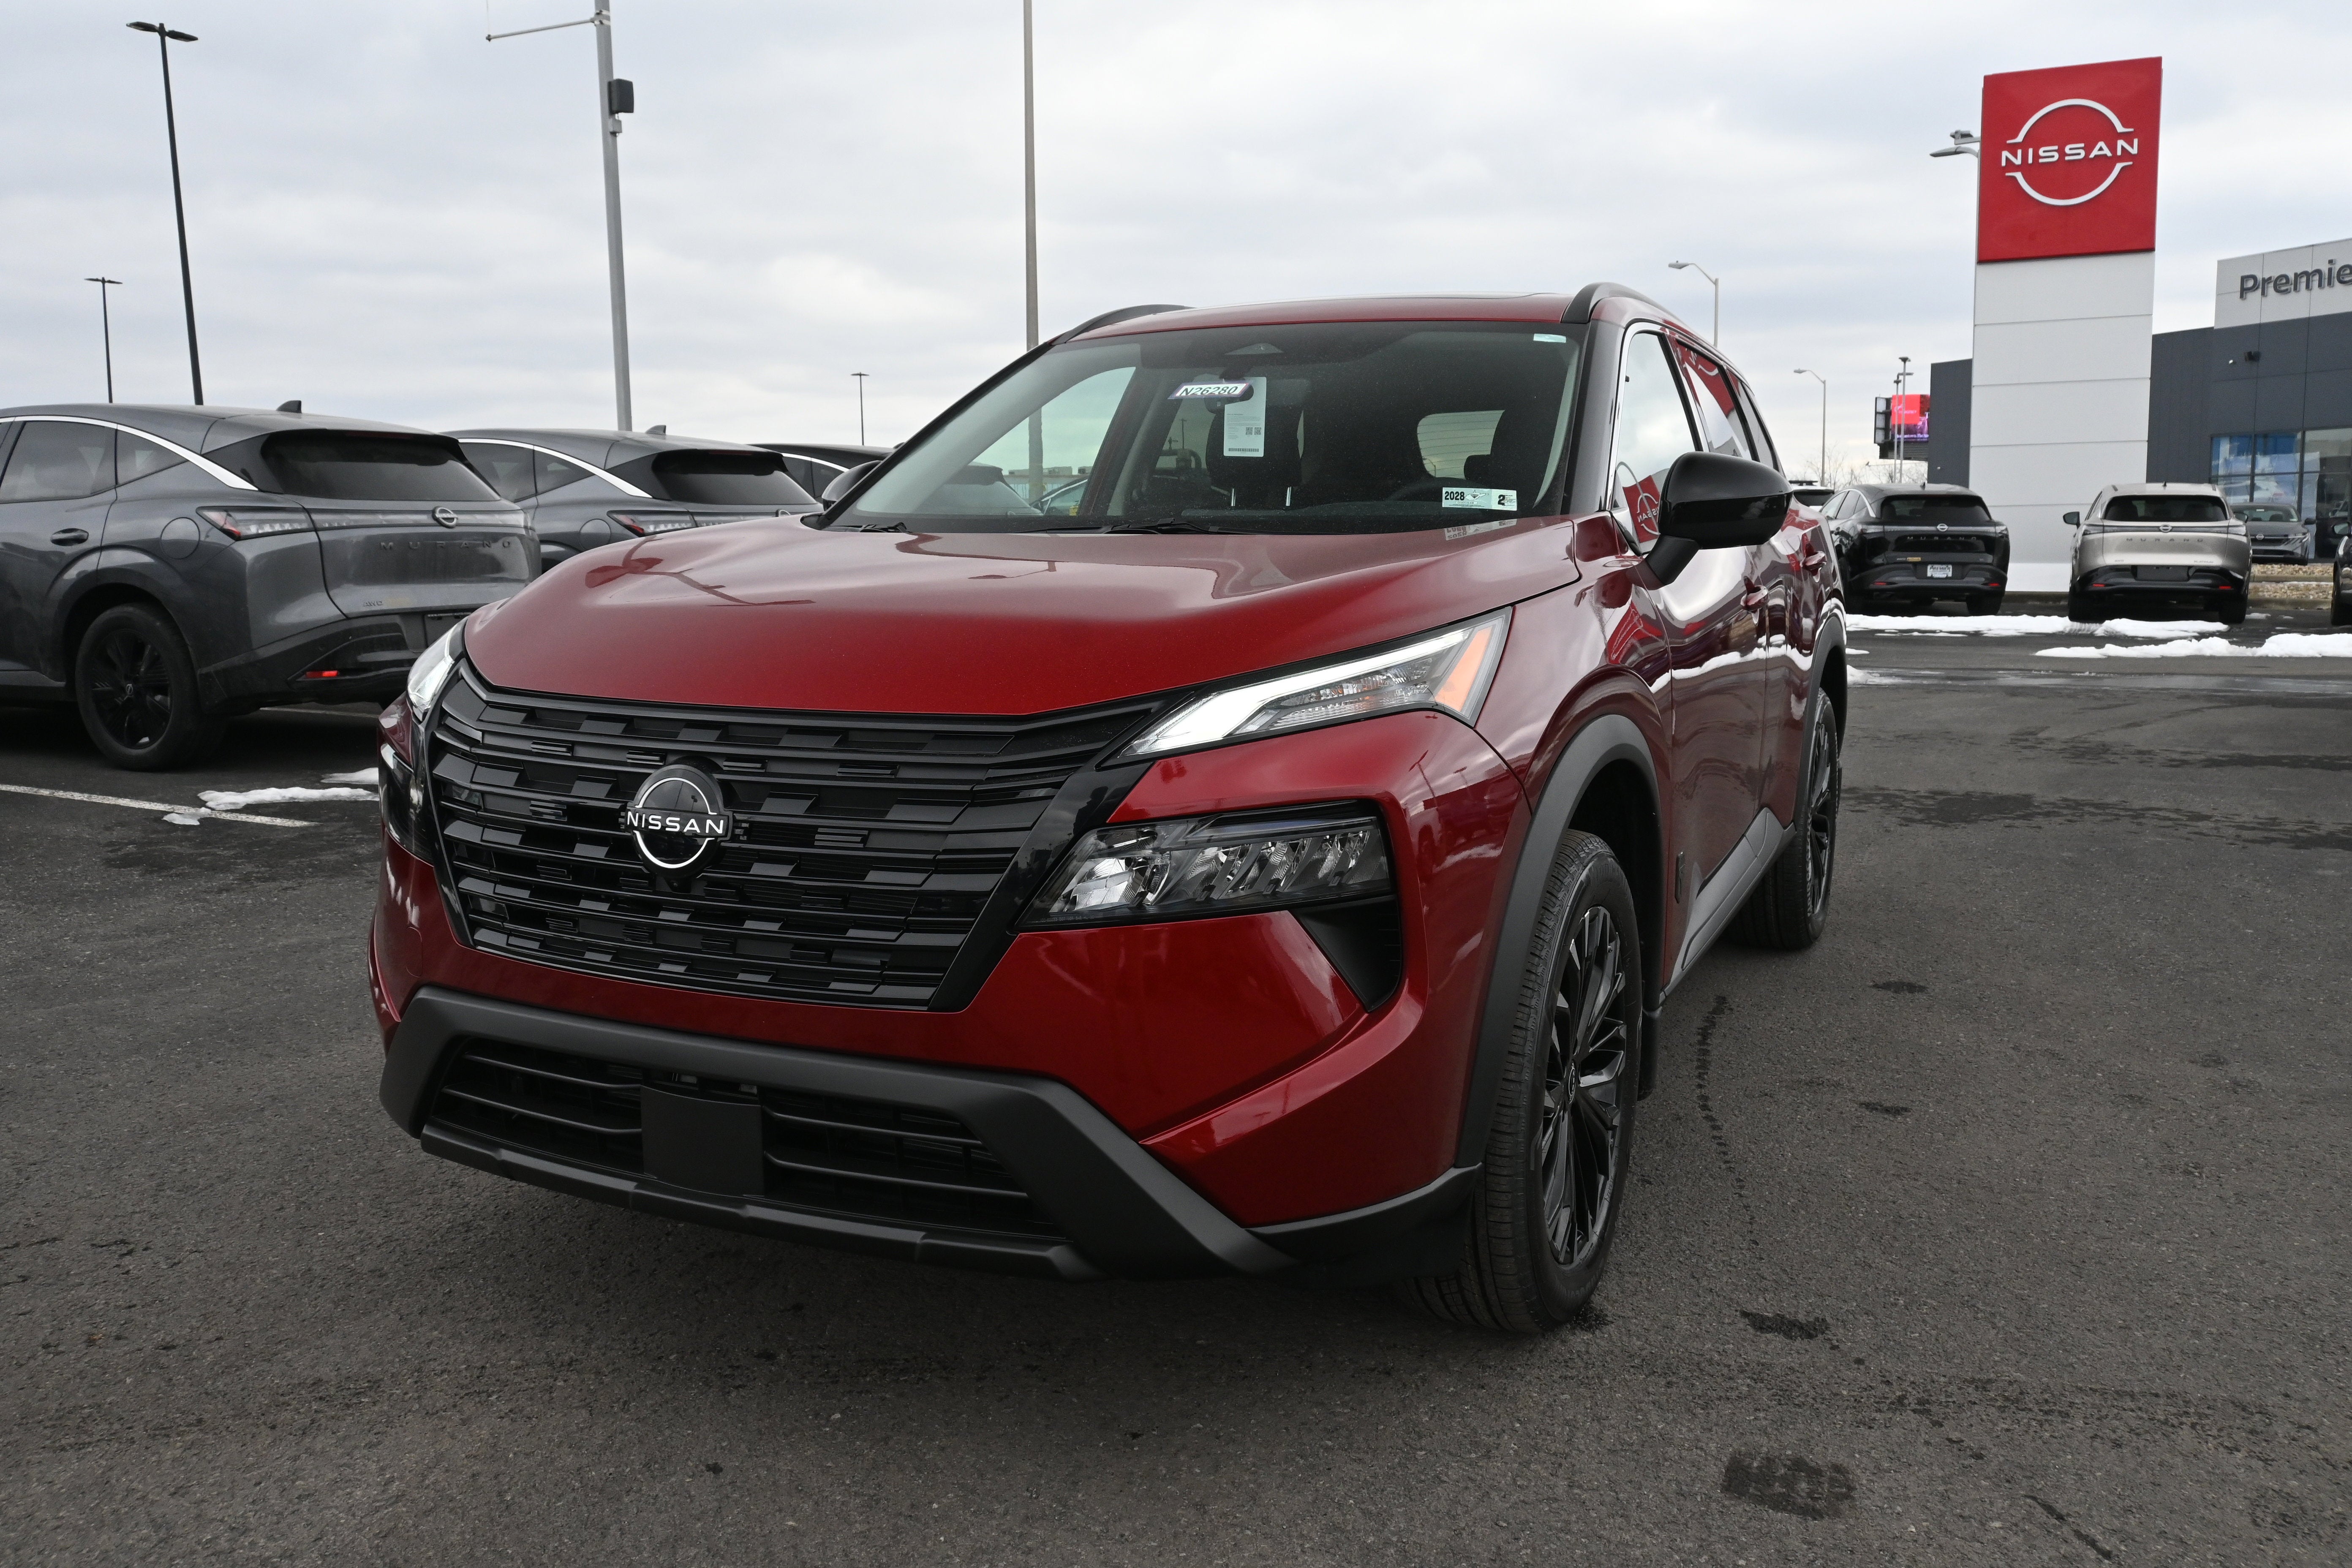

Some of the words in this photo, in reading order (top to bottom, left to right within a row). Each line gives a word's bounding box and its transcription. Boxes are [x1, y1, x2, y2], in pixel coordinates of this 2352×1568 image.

[2001, 138, 2138, 167] NISSAN
[2240, 259, 2352, 299] Premie
[1180, 386, 1239, 395] N26280
[1444, 491, 1465, 501] 2028
[1498, 495, 1505, 506] 2
[380, 540, 510, 550] MURANO
[627, 811, 724, 834] NISSAN
